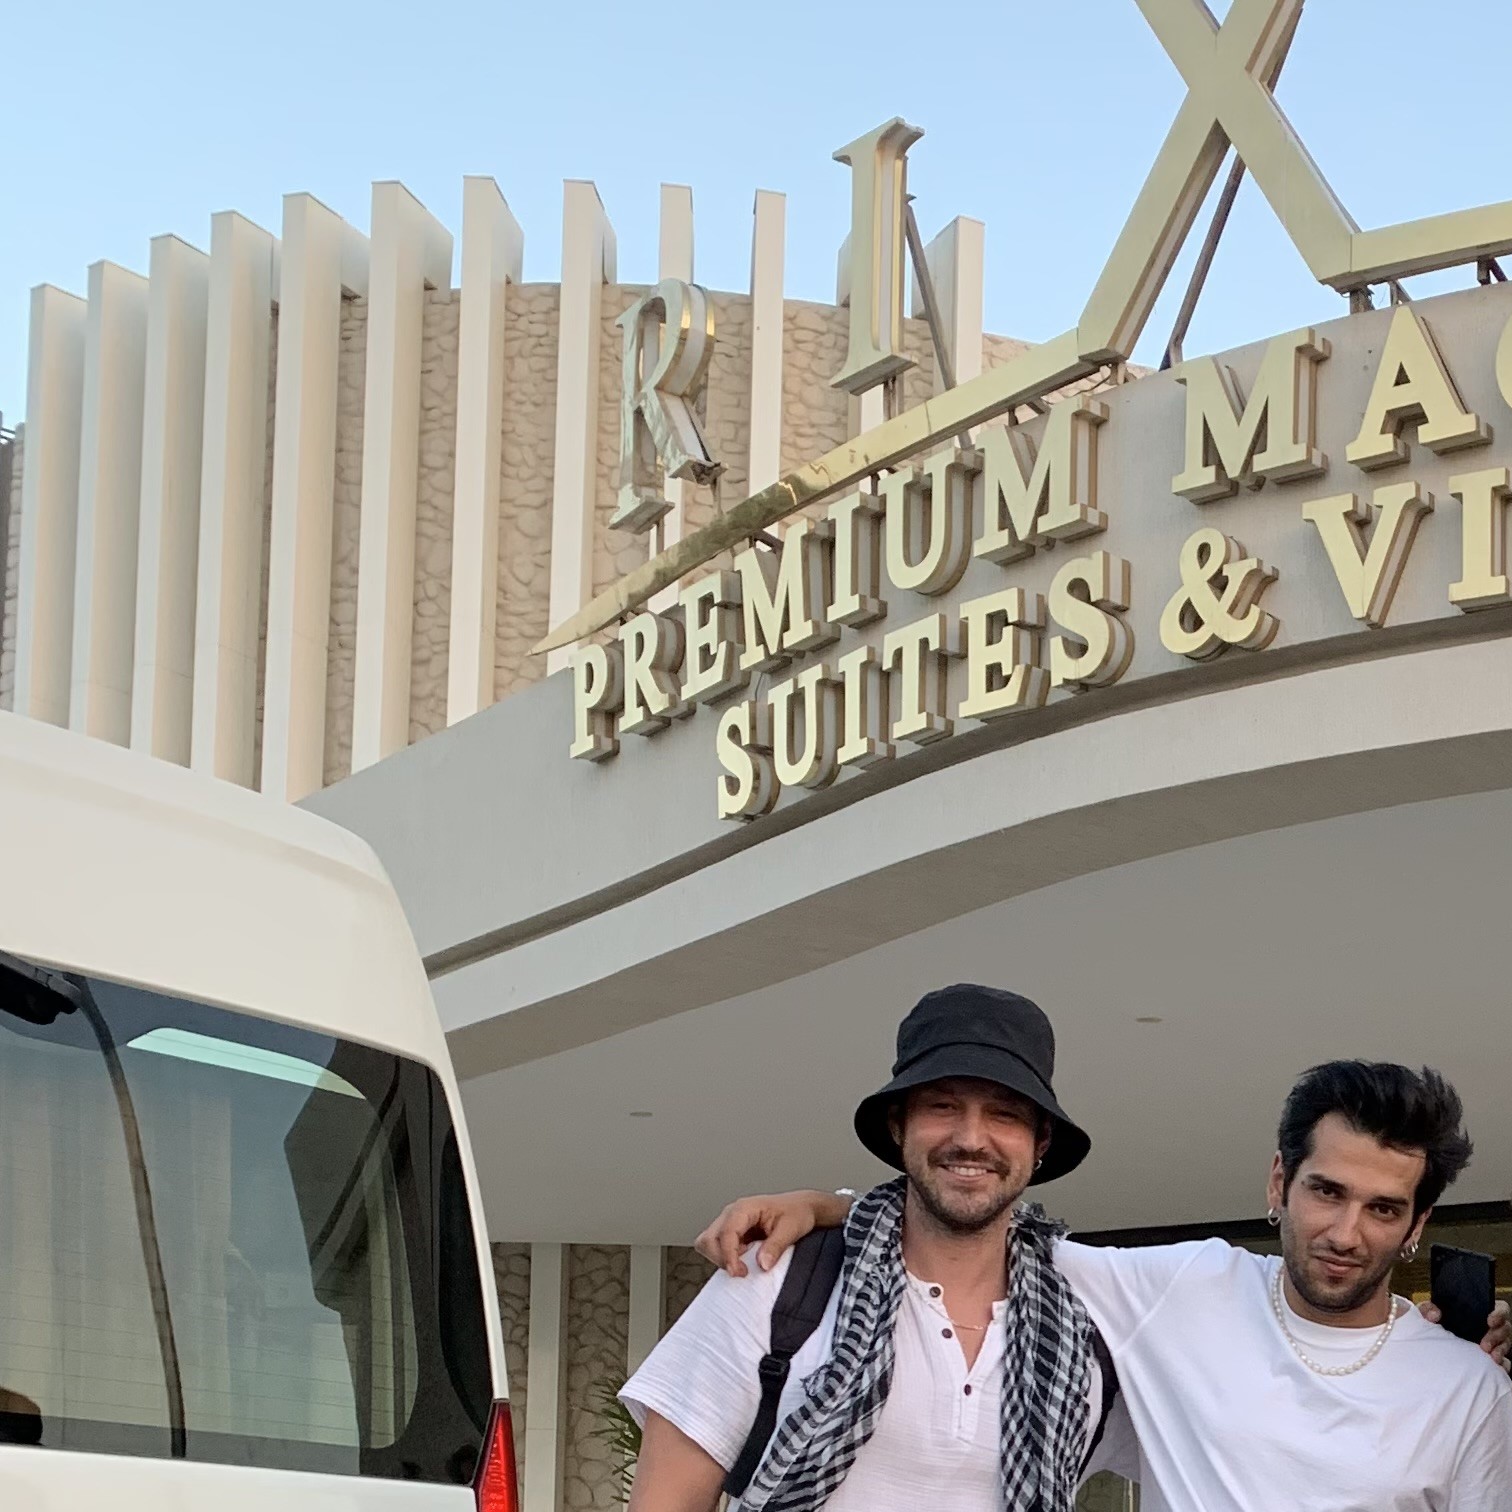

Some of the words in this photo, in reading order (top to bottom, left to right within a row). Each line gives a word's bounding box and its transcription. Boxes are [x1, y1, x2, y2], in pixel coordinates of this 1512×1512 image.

[568, 400, 1109, 762] PREMIUM
[717, 550, 1134, 822] SUITES
[1159, 527, 1280, 660] &
